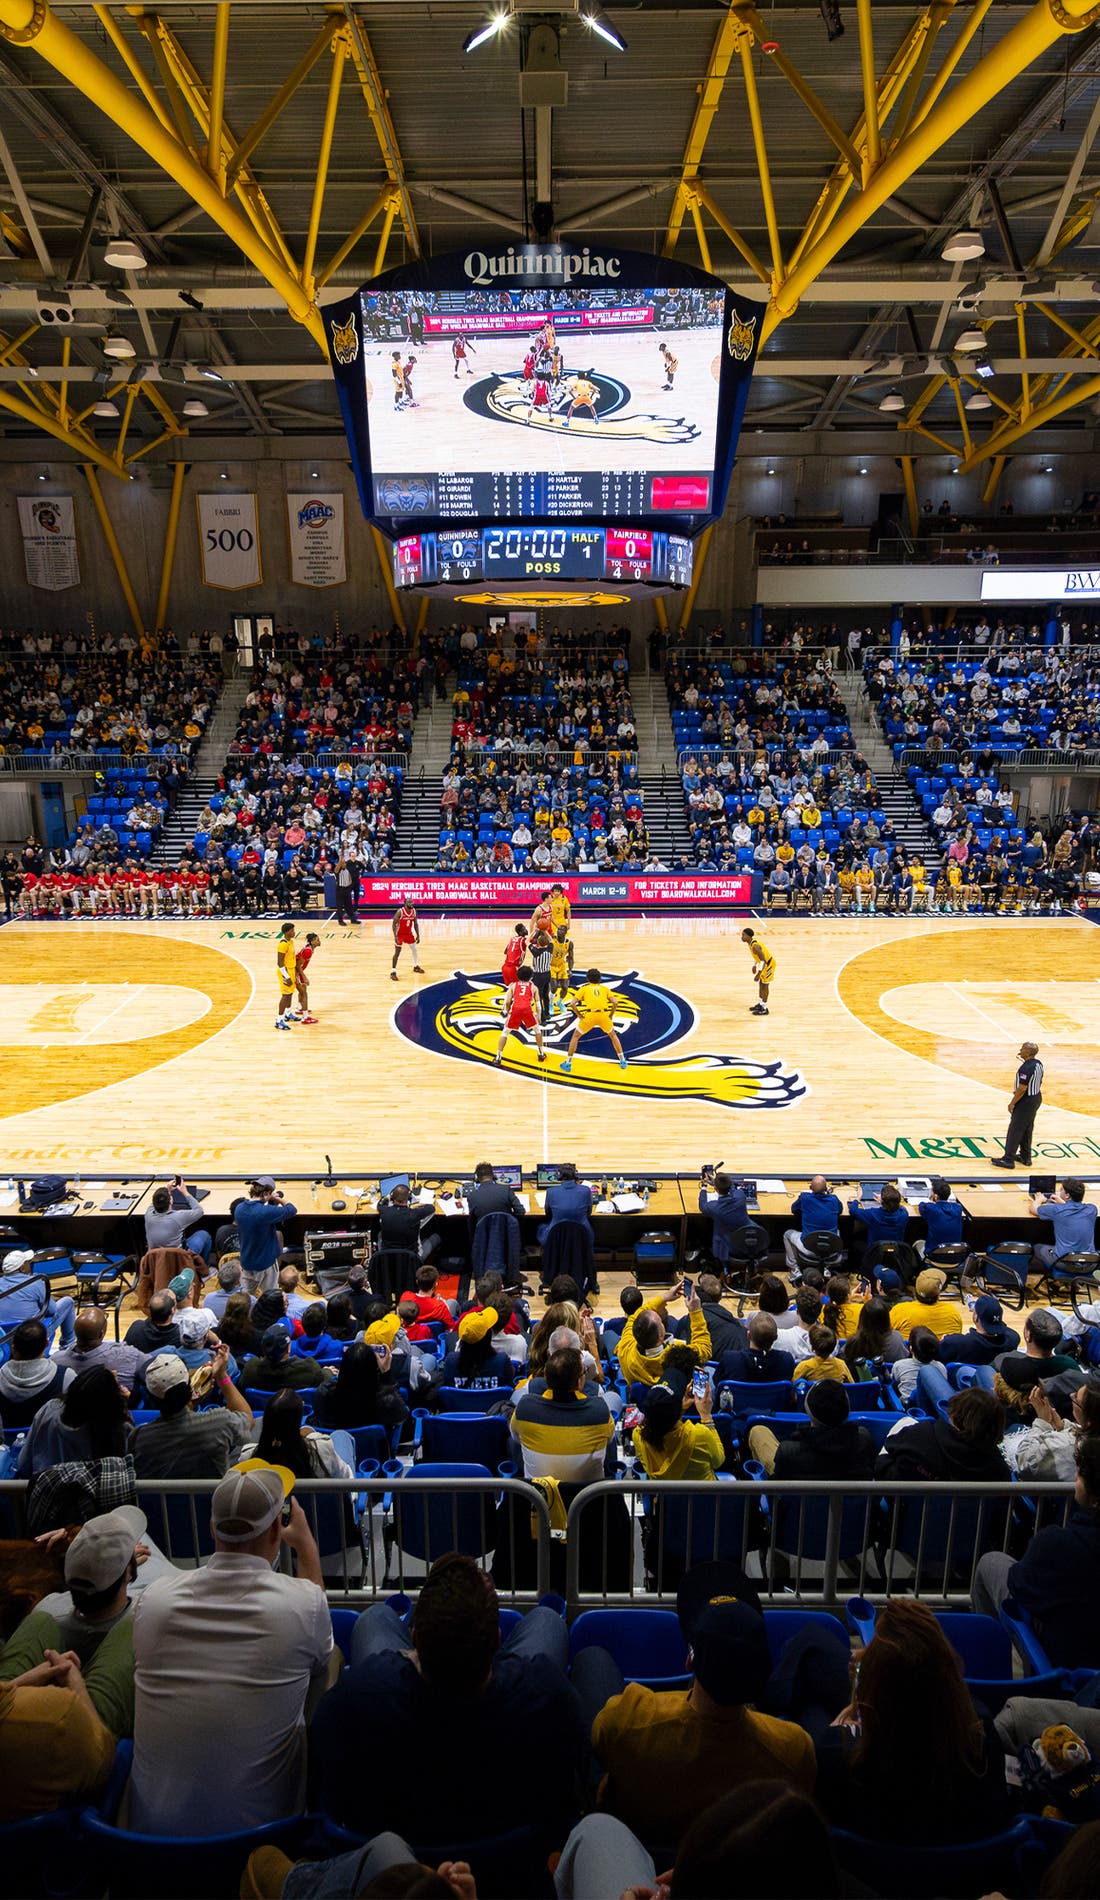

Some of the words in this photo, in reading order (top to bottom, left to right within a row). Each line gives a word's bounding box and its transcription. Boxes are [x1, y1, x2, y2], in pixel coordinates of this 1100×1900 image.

[464, 247, 621, 285] Quinnipiac
[298, 505, 333, 529] MAAC
[207, 528, 254, 552] 500
[438, 531, 479, 541] QUINNIPIAC
[571, 533, 600, 543] HALF
[613, 531, 648, 540] FAIRFIELD
[452, 540, 464, 558] 0
[487, 530, 567, 559] 20:00
[625, 540, 636, 558] 0
[404, 547, 411, 564] 0
[582, 546, 591, 559] 1
[676, 546, 683, 562] 0
[525, 562, 561, 573] POSS
[629, 561, 647, 569] FOULS
[442, 569, 451, 580] 4
[462, 568, 470, 579] 0
[612, 567, 622, 579] 4
[634, 568, 642, 579] 0
[372, 882, 389, 891] 2024
[391, 882, 424, 891] HERCULES
[426, 882, 446, 891] TIRES
[448, 882, 469, 891] MAAC
[471, 882, 514, 891] BASKETBALL
[582, 887, 605, 895] MARCH
[634, 881, 648, 890] FOR
[650, 881, 678, 890] TICKETS
[681, 881, 695, 889] AND
[697, 881, 742, 889] INFORMATION
[389, 891, 402, 900] JIM
[404, 891, 433, 900] WHELAN
[435, 891, 478, 900] BOARDWALK
[480, 891, 497, 900] HALL
[640, 890, 658, 899] VISIT
[661, 890, 736, 899] BOARDWALKHALL.COM
[519, 985, 527, 996] 3
[111, 1143, 233, 1160] Court
[857, 1136, 993, 1159] M&T
